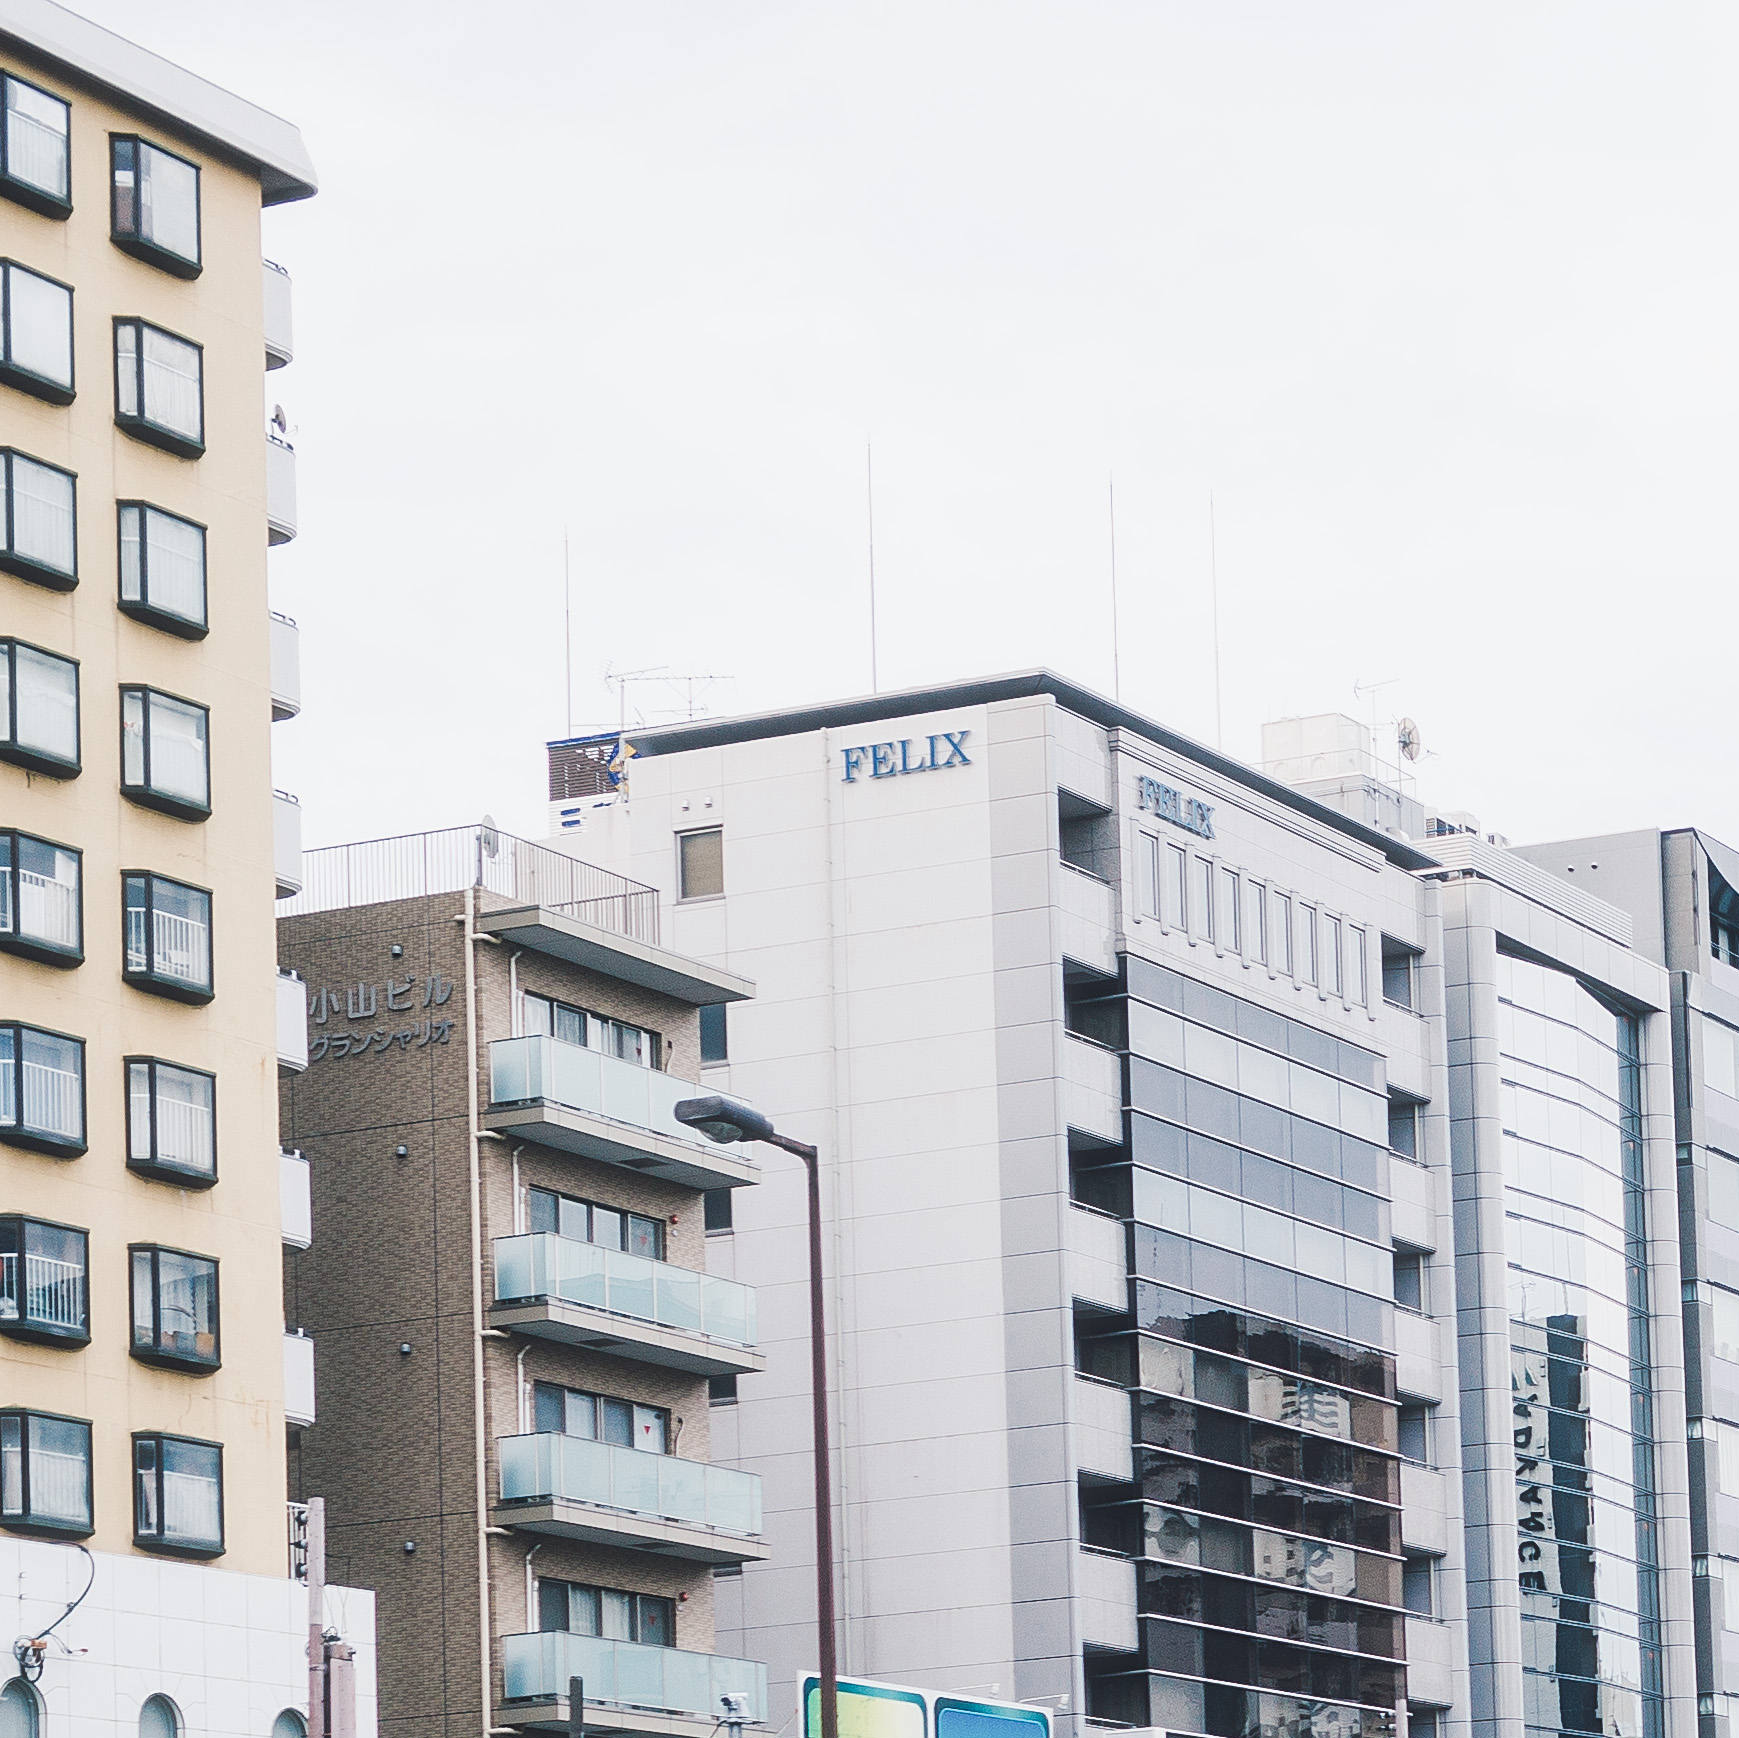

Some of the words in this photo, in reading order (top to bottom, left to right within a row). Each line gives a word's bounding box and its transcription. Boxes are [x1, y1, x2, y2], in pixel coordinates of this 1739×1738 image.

[841, 730, 973, 783] FELIX
[1138, 776, 1216, 839] FELIX
[309, 974, 452, 1024] 小山ビル
[309, 1020, 455, 1062] グランシャリオ
